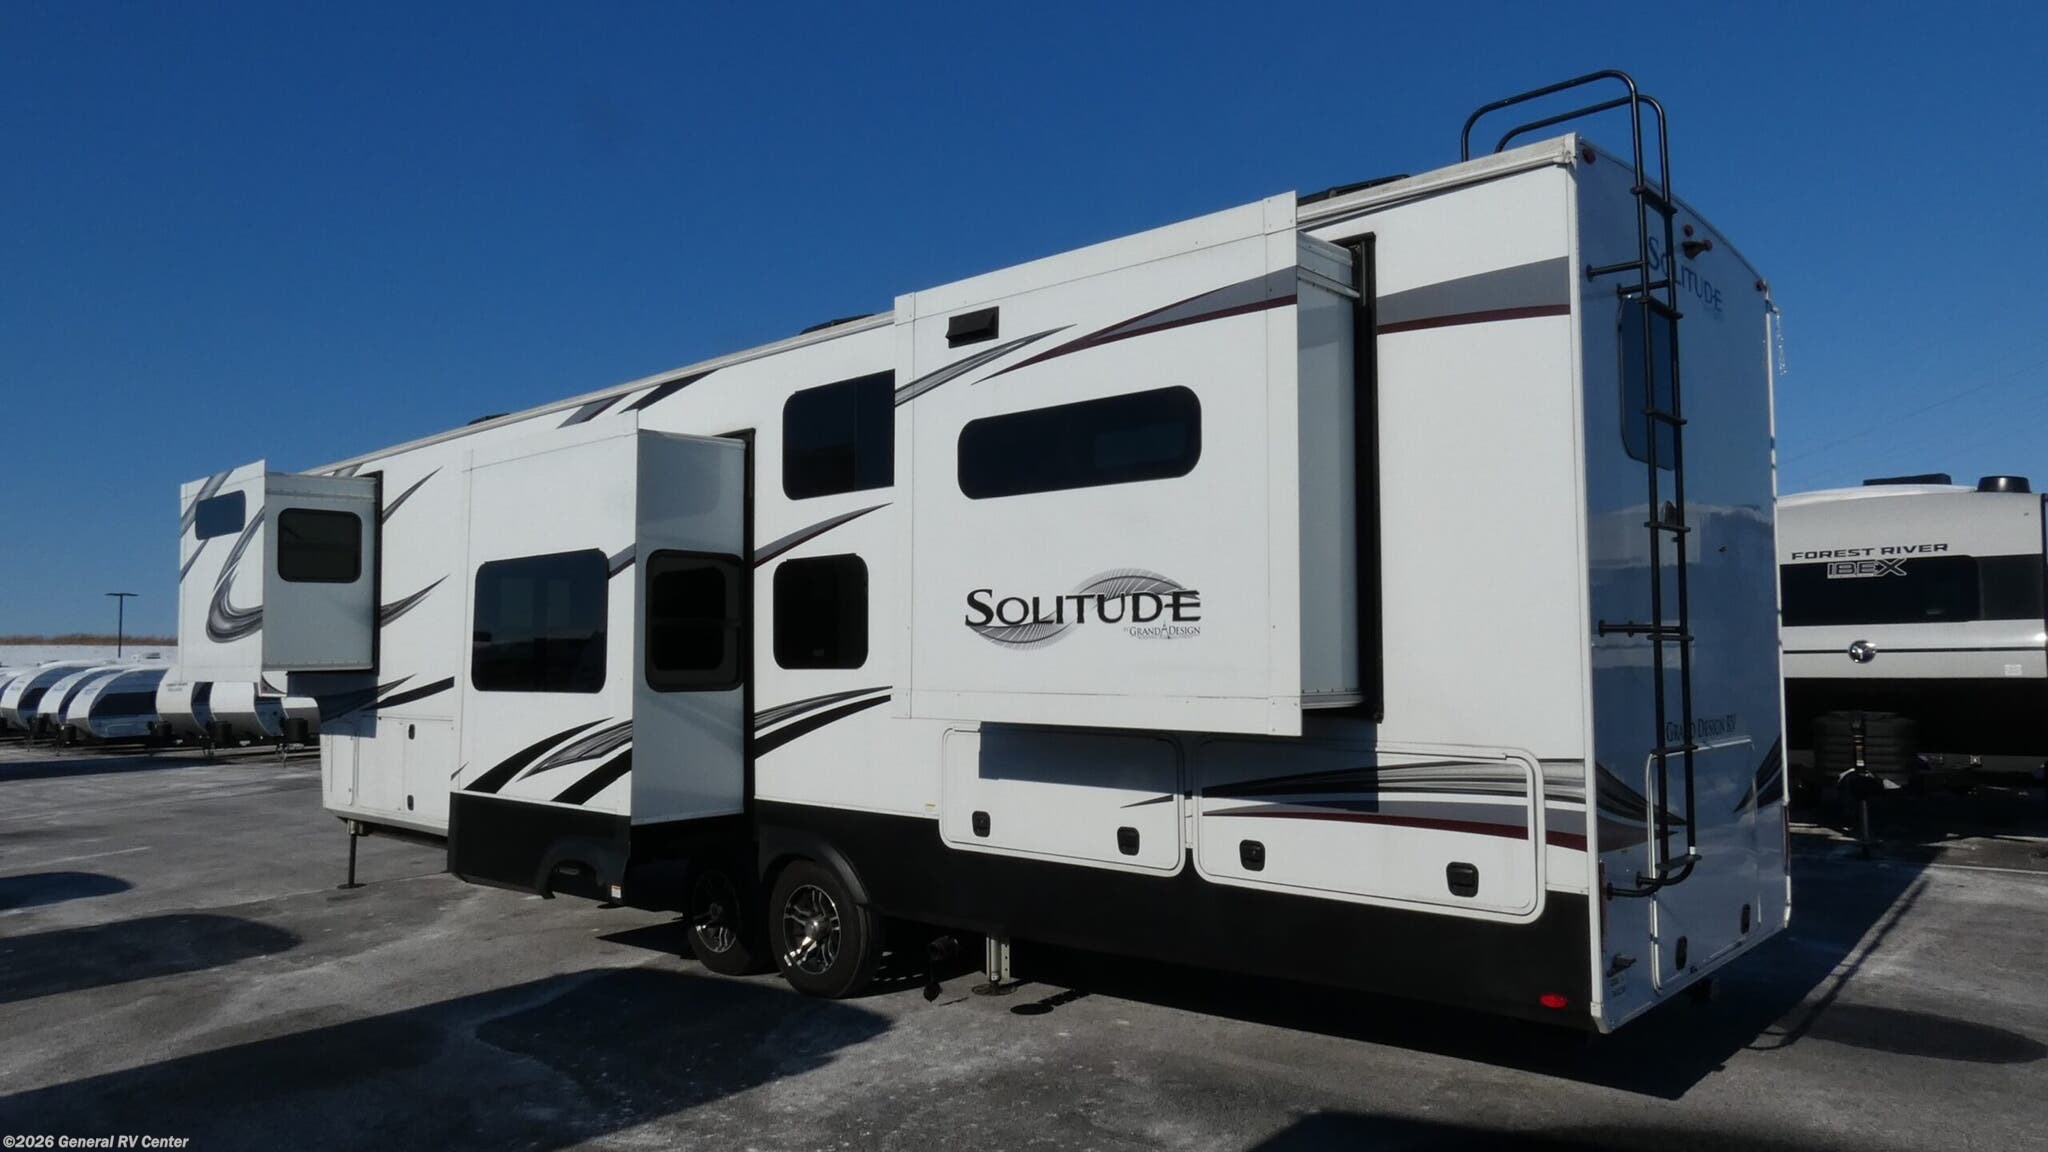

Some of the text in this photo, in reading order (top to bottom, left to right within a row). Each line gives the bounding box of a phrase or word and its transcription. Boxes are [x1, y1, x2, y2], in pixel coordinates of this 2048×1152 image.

[1791, 543, 1949, 560] FOREST RIVER
[1827, 558, 1907, 579] IBEX
[965, 589, 1201, 626] SOLITUDE
[1129, 626, 1160, 636] GRAND
[1168, 625, 1200, 635] DESIGN
[1666, 722, 1695, 741] GRAD
